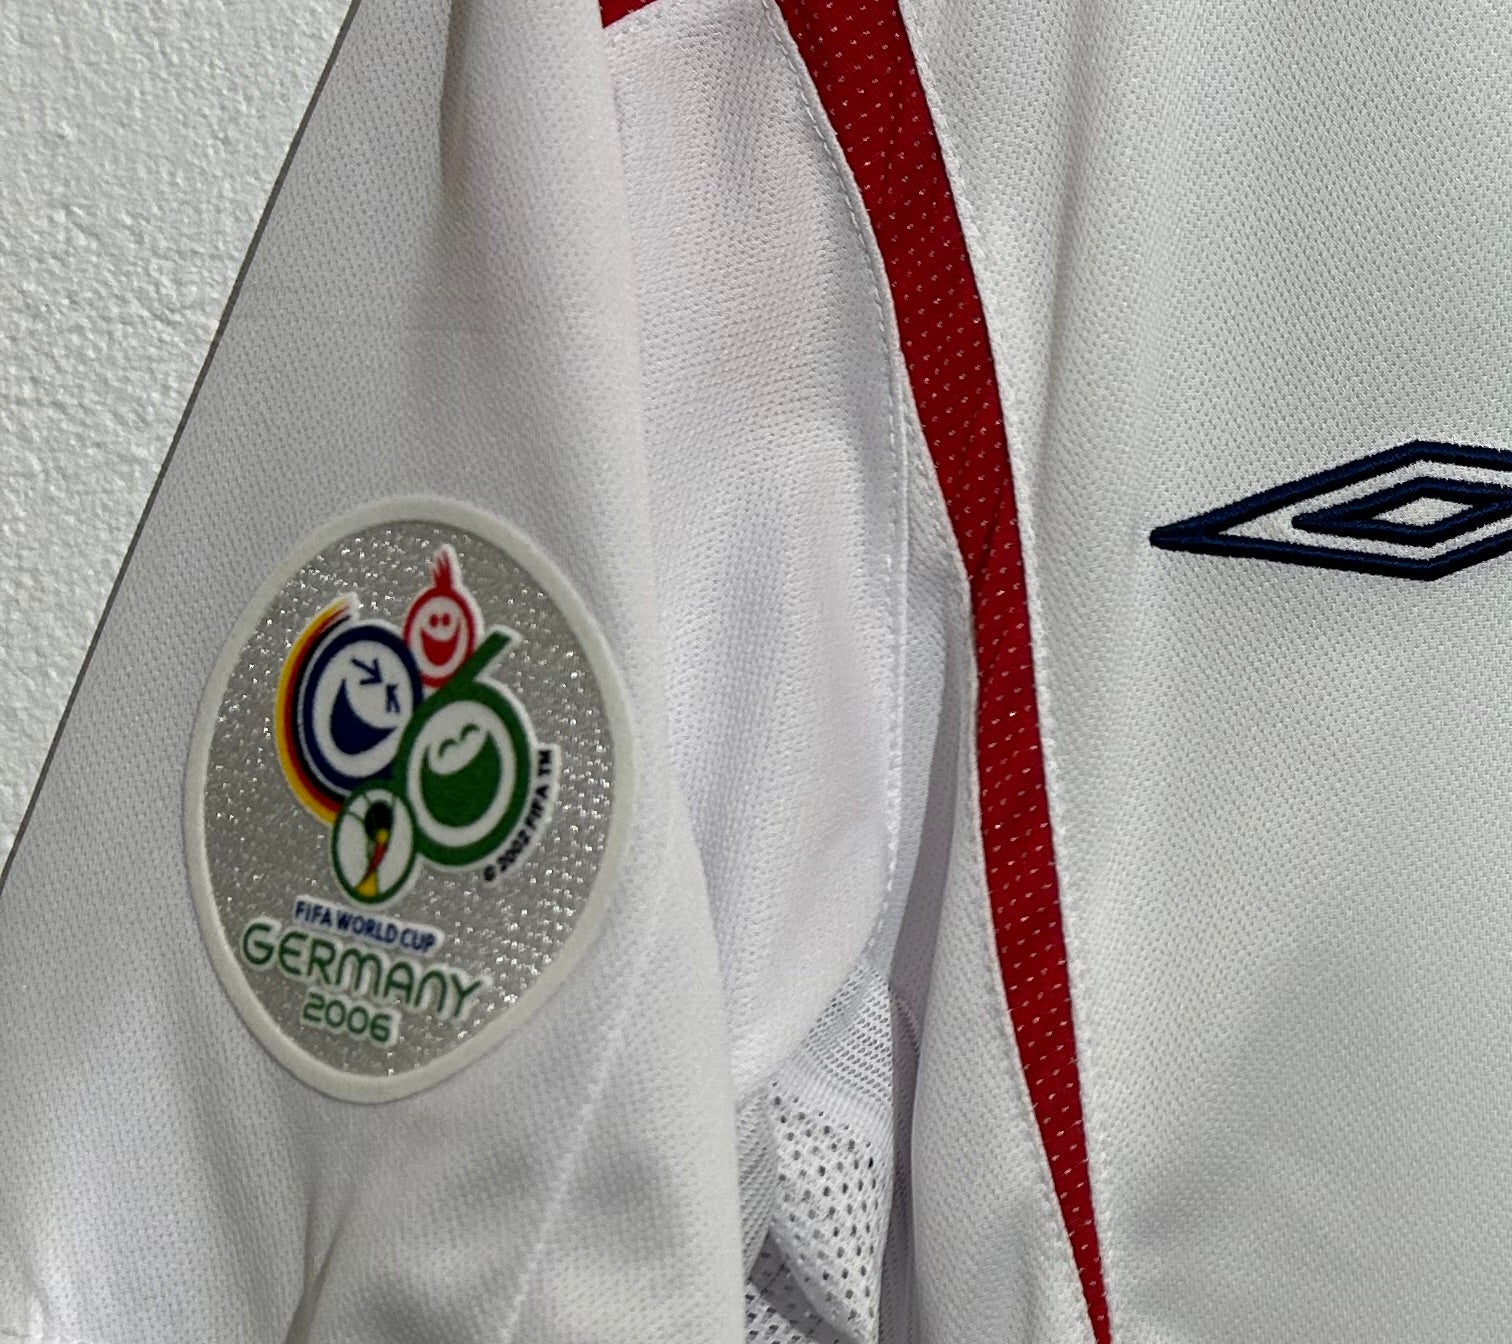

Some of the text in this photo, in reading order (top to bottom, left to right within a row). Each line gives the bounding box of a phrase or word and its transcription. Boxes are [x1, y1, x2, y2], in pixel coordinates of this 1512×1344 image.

[524, 784, 551, 831] FIFA
[294, 900, 437, 953] FIFA WORLD CUP
[242, 921, 483, 1019] GERMANY
[302, 991, 393, 1044] 2006
